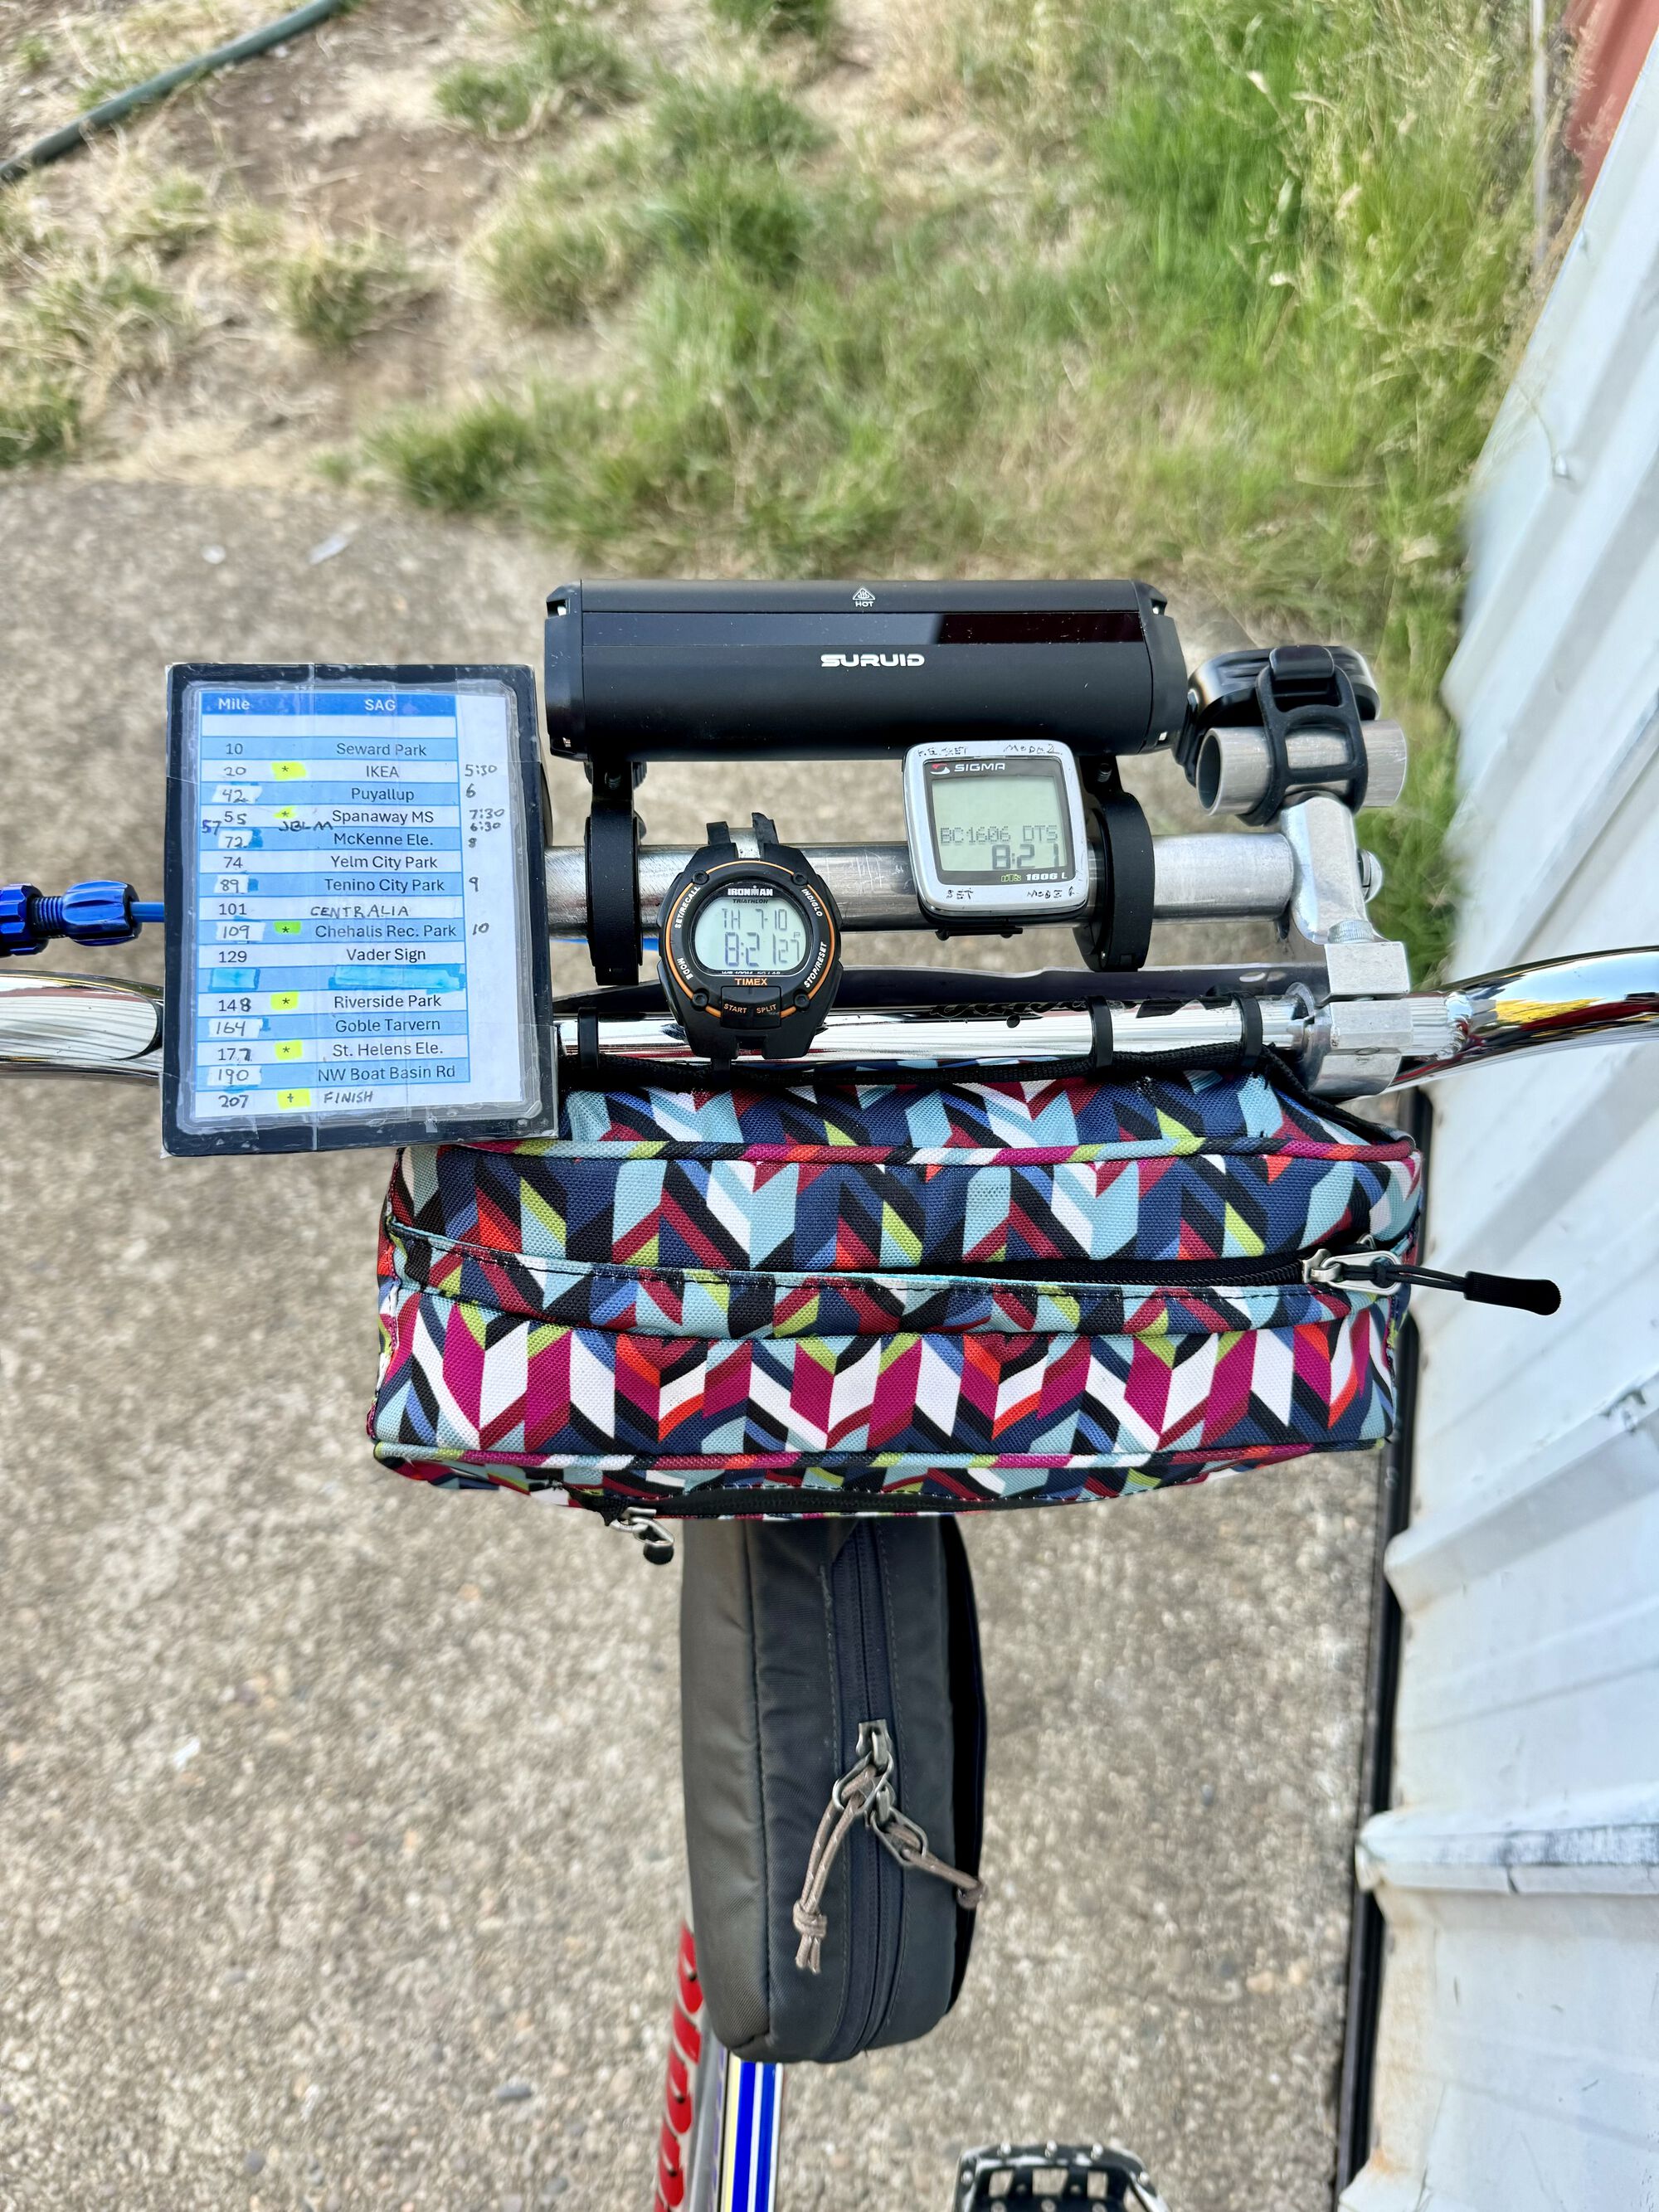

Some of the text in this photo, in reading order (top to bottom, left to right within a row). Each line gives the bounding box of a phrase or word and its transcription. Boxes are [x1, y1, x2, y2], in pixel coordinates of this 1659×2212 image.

[820, 654, 925, 668] SURUID
[218, 698, 250, 710] Mile
[365, 698, 397, 712] SAG
[226, 743, 243, 755] 10
[337, 742, 427, 756] Seward Park
[224, 766, 246, 776] 20
[366, 765, 400, 778] IKEA
[465, 764, 498, 776] 5:30
[954, 763, 1005, 772] SIGMA
[222, 789, 248, 803] 42
[352, 787, 415, 803] Puyallup
[465, 783, 476, 798] 6
[224, 810, 247, 824] 55
[332, 809, 434, 825] Spanaway MS
[469, 808, 504, 819] 7:30
[202, 819, 221, 835] 57
[469, 821, 501, 832] 6:30
[1023, 824, 1058, 842] DTS
[333, 833, 433, 846] McKenne Ele.
[468, 837, 477, 848] 8
[223, 857, 243, 868] 74
[331, 855, 438, 870] Yelm City Park
[991, 843, 1059, 871] 8:21
[220, 879, 239, 893] 89
[324, 878, 445, 893] Tenino City Park
[469, 876, 479, 892] 9
[727, 886, 773, 896] IRONMAN
[219, 903, 247, 915] 101
[674, 886, 701, 929] SET/RECALL
[801, 888, 823, 917] INDIGLO
[310, 904, 409, 919] CENTRALIA
[721, 908, 741, 930] TH
[223, 925, 250, 939] 109
[315, 925, 456, 938] Chehalis Rec. Park
[472, 922, 489, 936] 10
[219, 950, 247, 963] 129
[347, 948, 426, 963] Vader Sign
[677, 957, 693, 980] MODE
[804, 941, 827, 988] STOP/RESET
[218, 997, 251, 1012] 148
[333, 994, 442, 1009] Riverside Park
[723, 1003, 776, 1014] START SPLIT
[216, 1020, 246, 1037] 164
[335, 1018, 440, 1033] Goble Tarvern
[333, 1042, 443, 1057] St. Helens Ele.
[218, 1068, 249, 1085] 190
[318, 1065, 455, 1082] NW Boat Basin Rd
[218, 1094, 249, 1108] 207
[324, 1091, 373, 1104] FINISH
